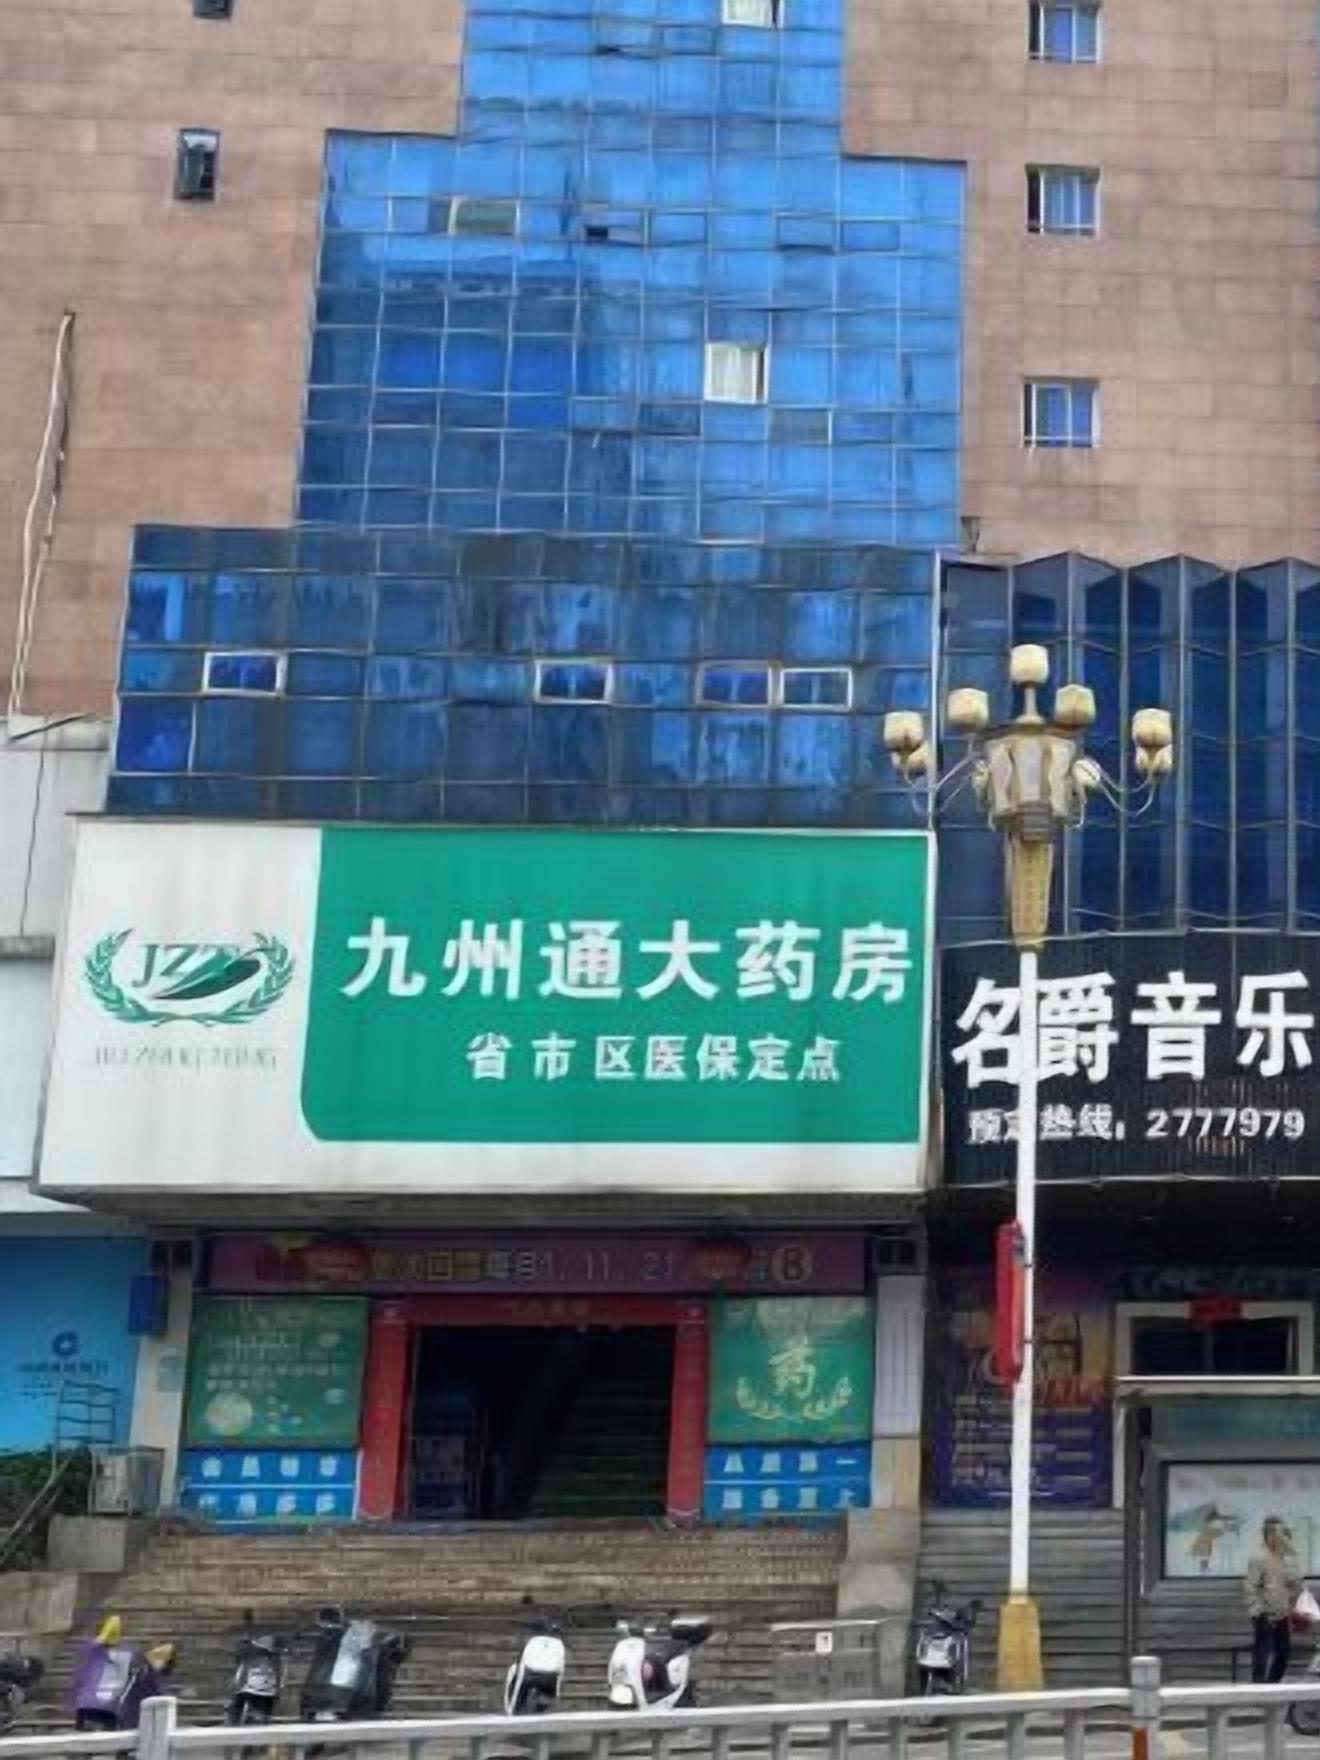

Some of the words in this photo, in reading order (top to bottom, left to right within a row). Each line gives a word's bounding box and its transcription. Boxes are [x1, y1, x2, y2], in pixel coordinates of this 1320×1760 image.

[340, 916, 914, 1002] 九州通大药房
[466, 1031, 842, 1082] 省市区医保定点
[1146, 1107, 1305, 1139] 2777979
